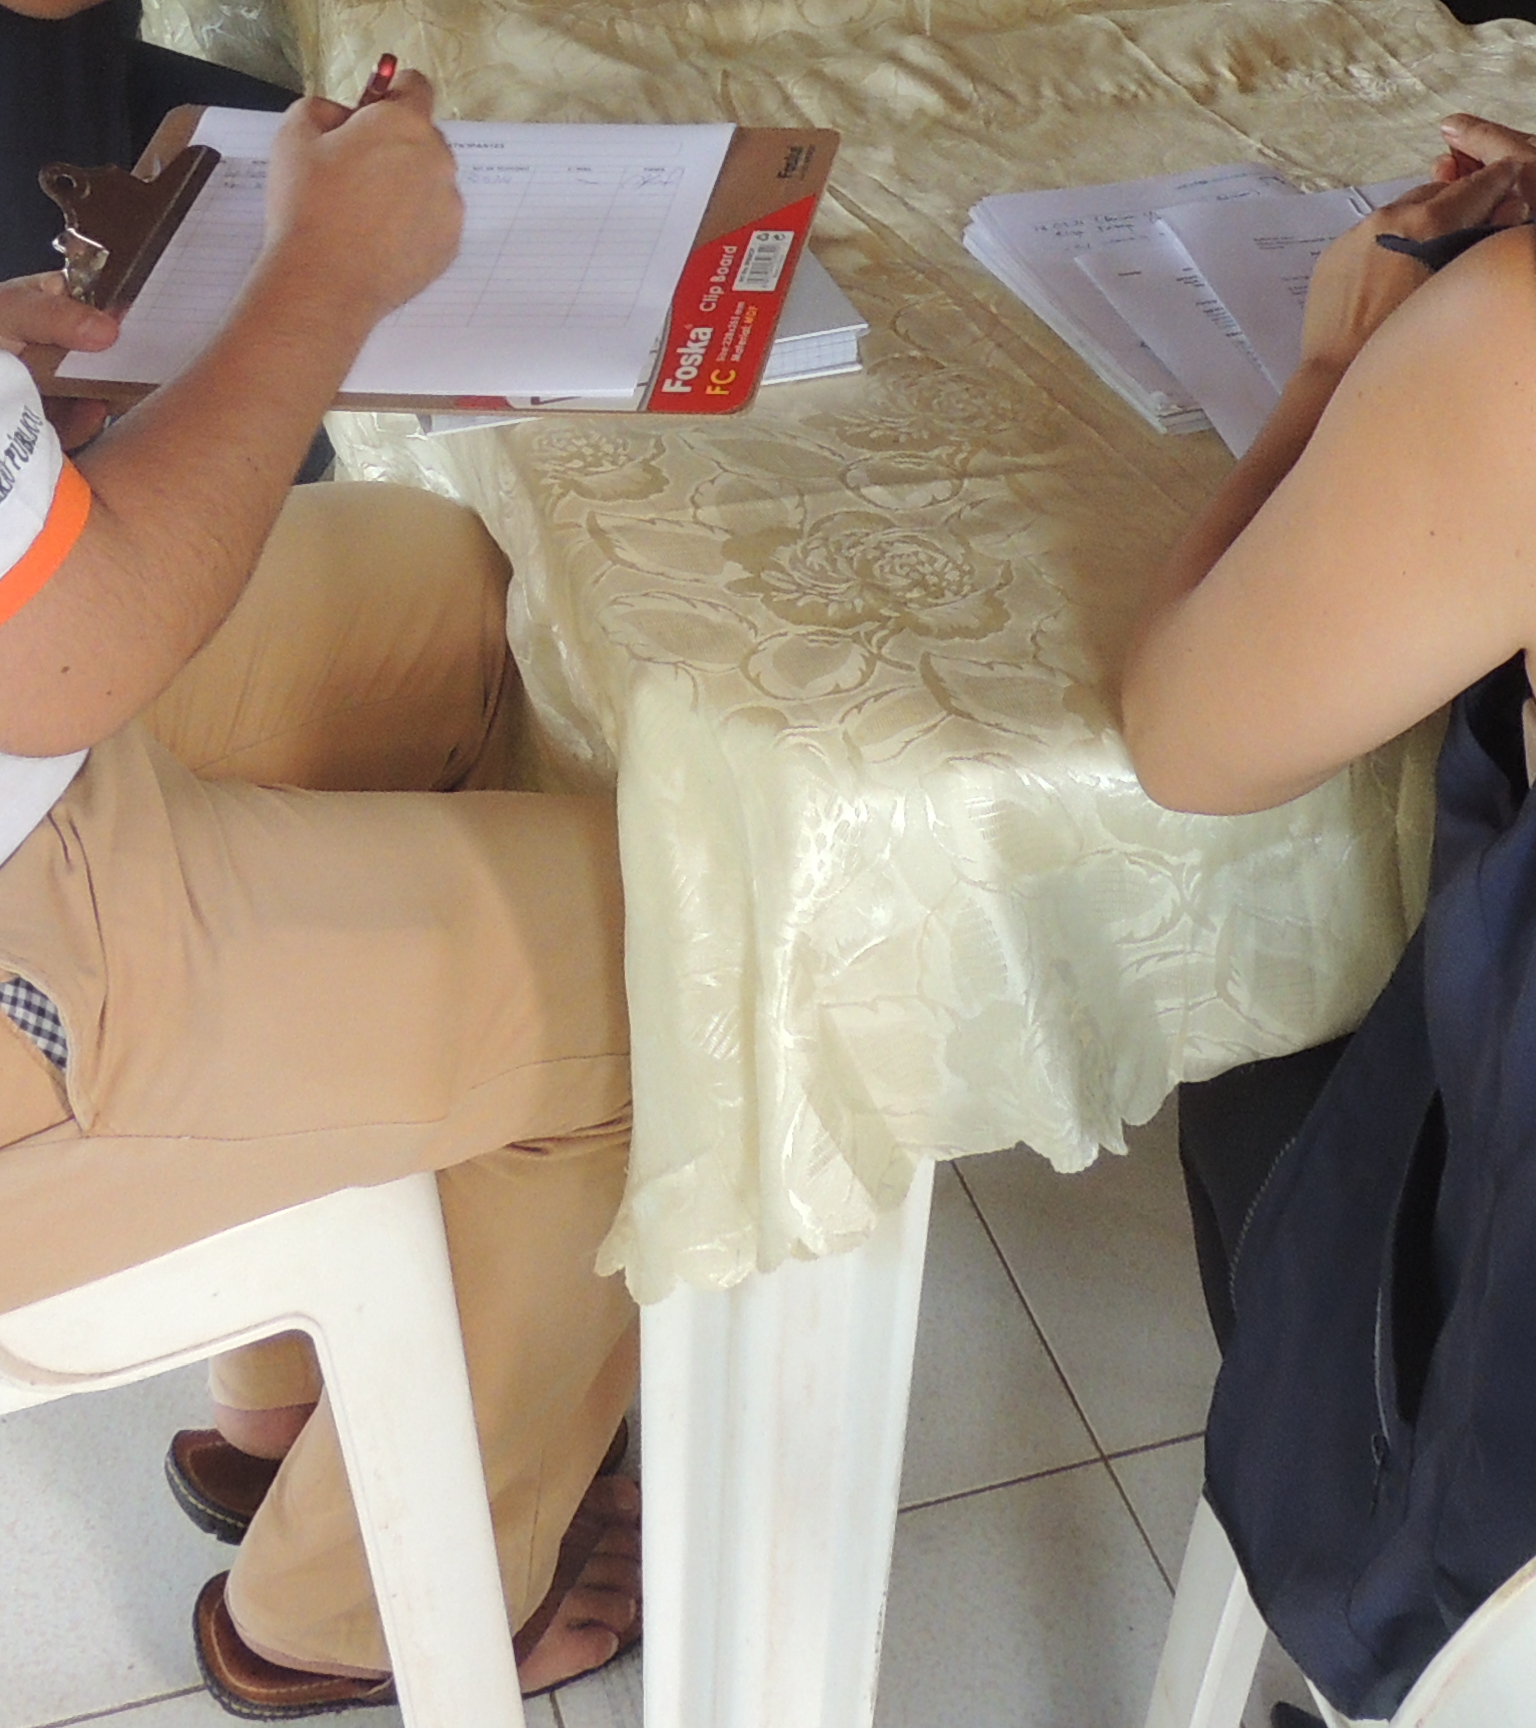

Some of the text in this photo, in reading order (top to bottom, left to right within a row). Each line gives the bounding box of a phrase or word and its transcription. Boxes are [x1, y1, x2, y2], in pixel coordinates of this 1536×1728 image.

[662, 245, 738, 393] Foska Clip Board
[705, 368, 737, 396] FC
